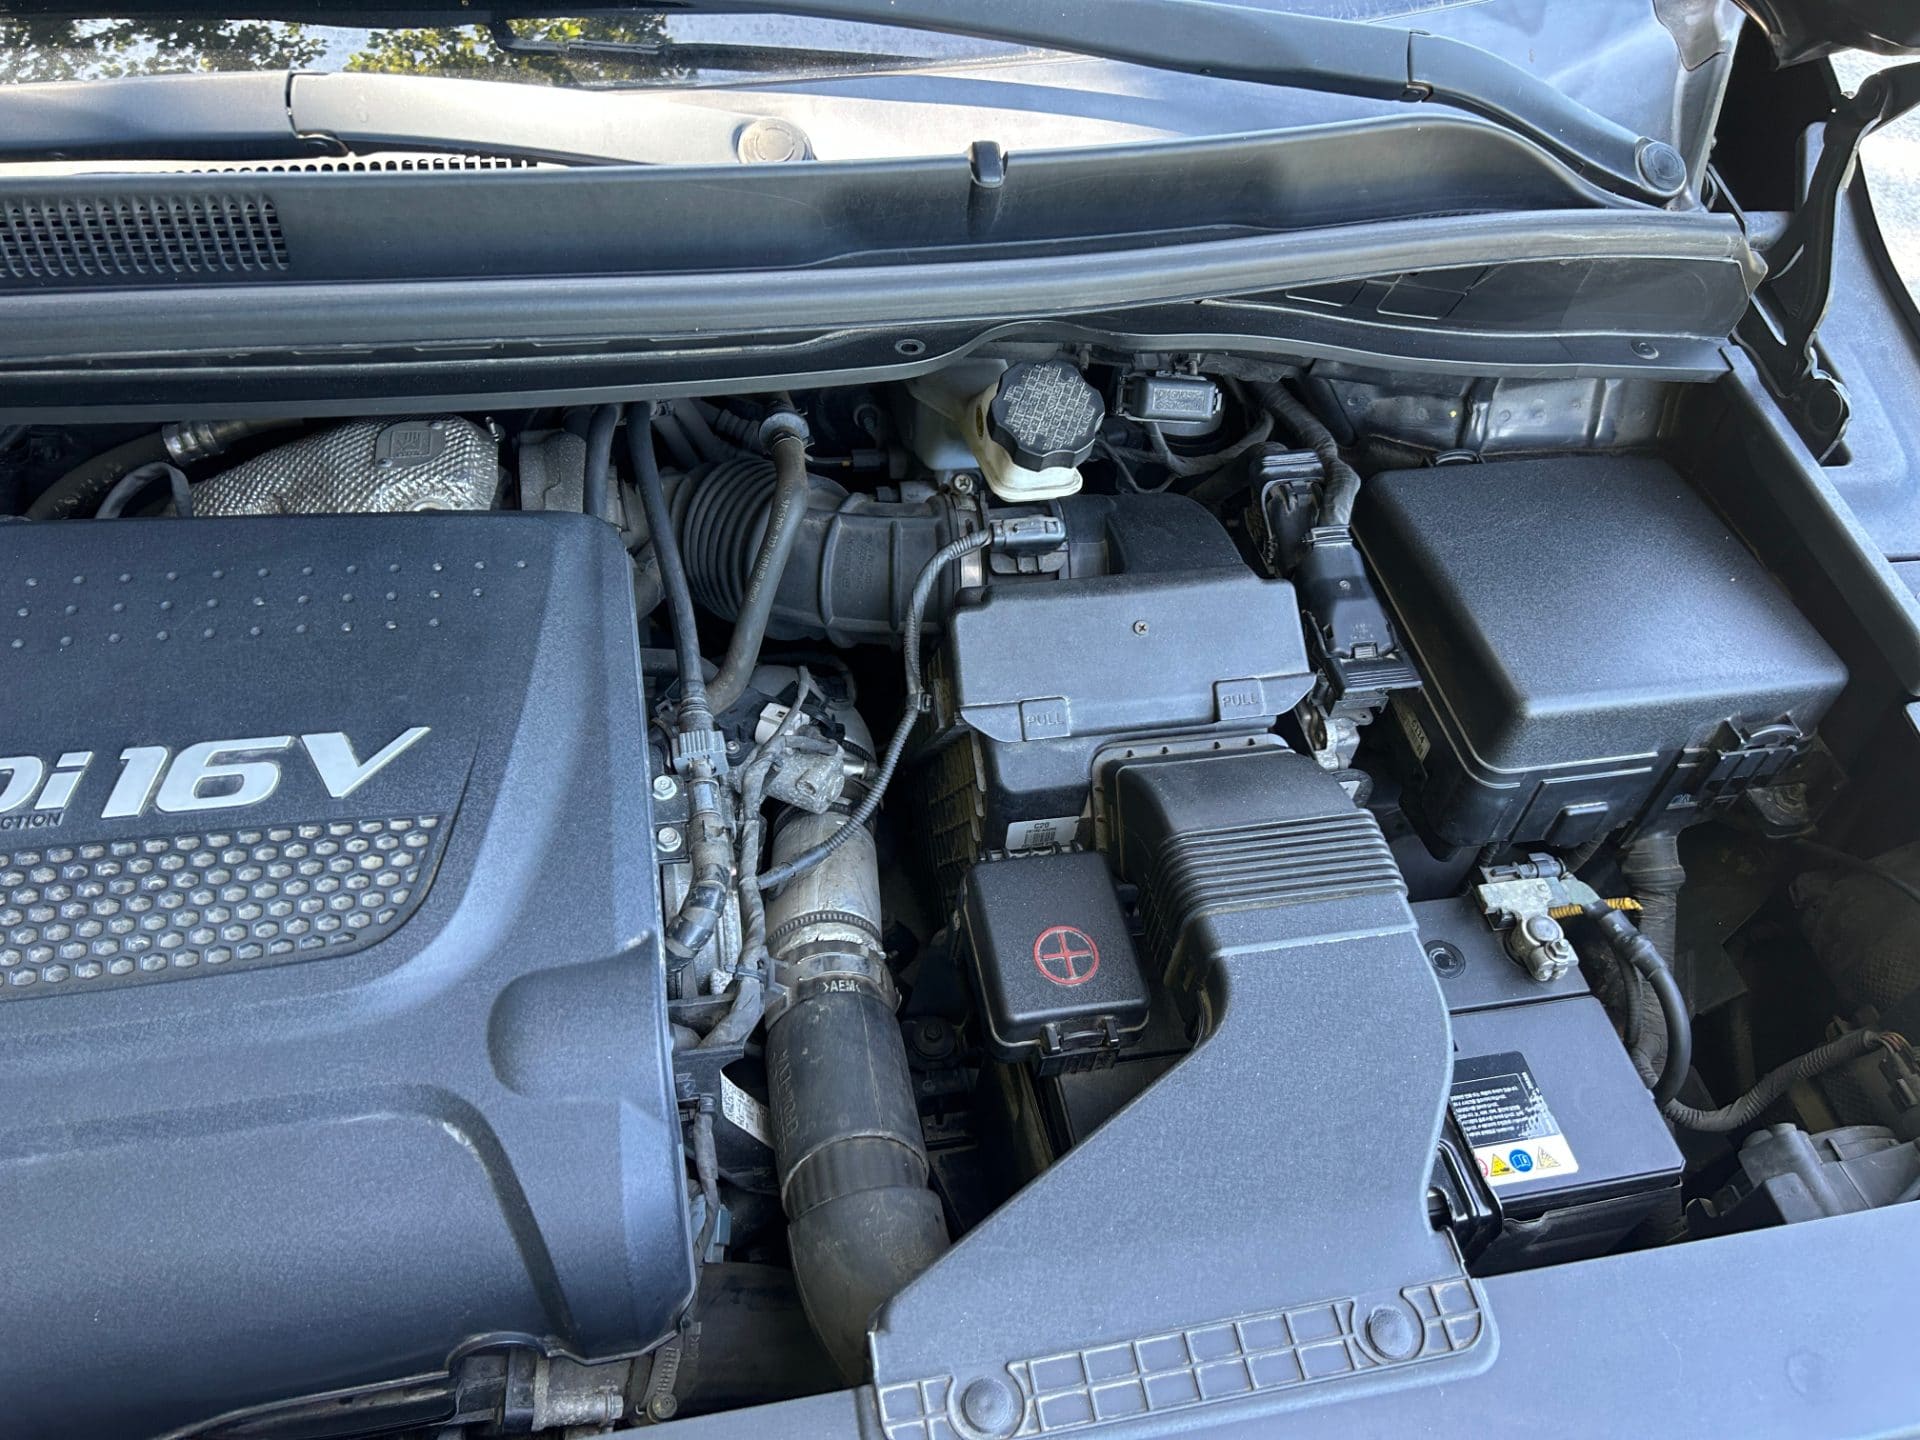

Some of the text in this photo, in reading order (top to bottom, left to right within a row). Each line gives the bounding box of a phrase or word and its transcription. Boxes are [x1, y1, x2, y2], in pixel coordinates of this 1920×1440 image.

[1222, 693, 1260, 707] PULL
[1026, 711, 1064, 726] PULL
[101, 726, 432, 819] 16V
